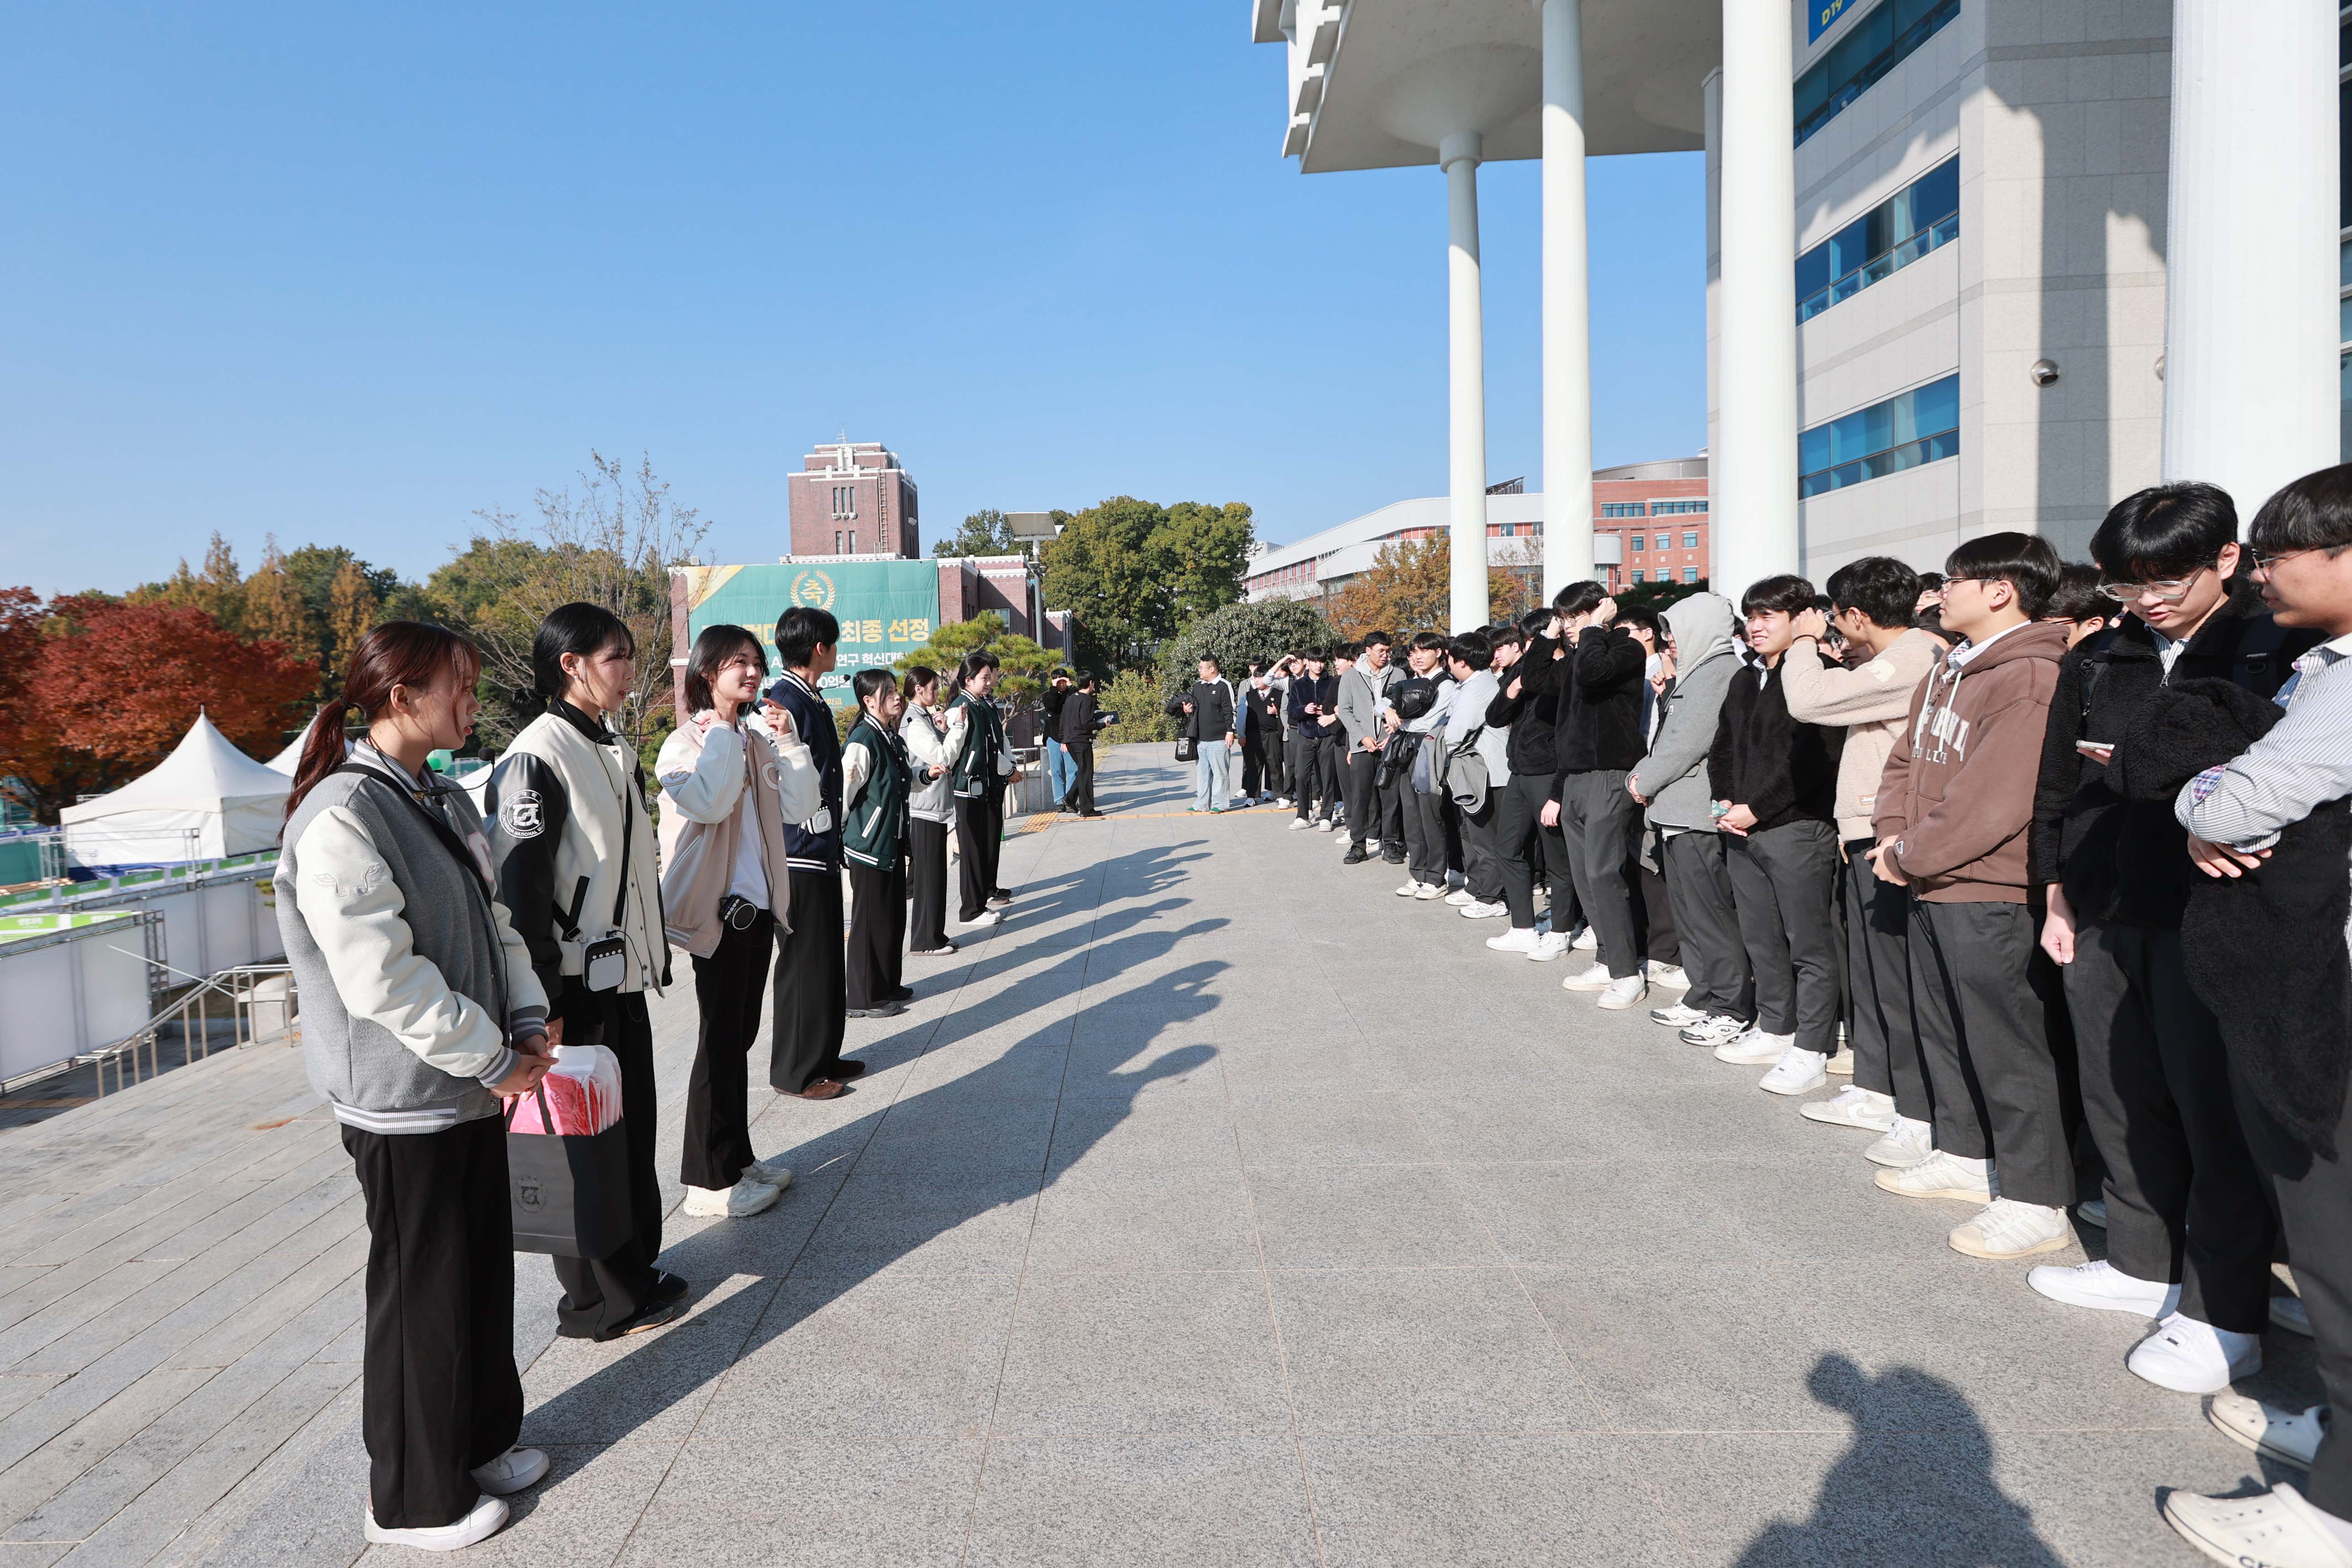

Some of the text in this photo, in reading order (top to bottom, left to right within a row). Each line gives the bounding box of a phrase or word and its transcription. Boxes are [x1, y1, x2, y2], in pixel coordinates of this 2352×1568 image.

[800, 579, 825, 604] 축
[841, 618, 929, 643] 최종 선정
